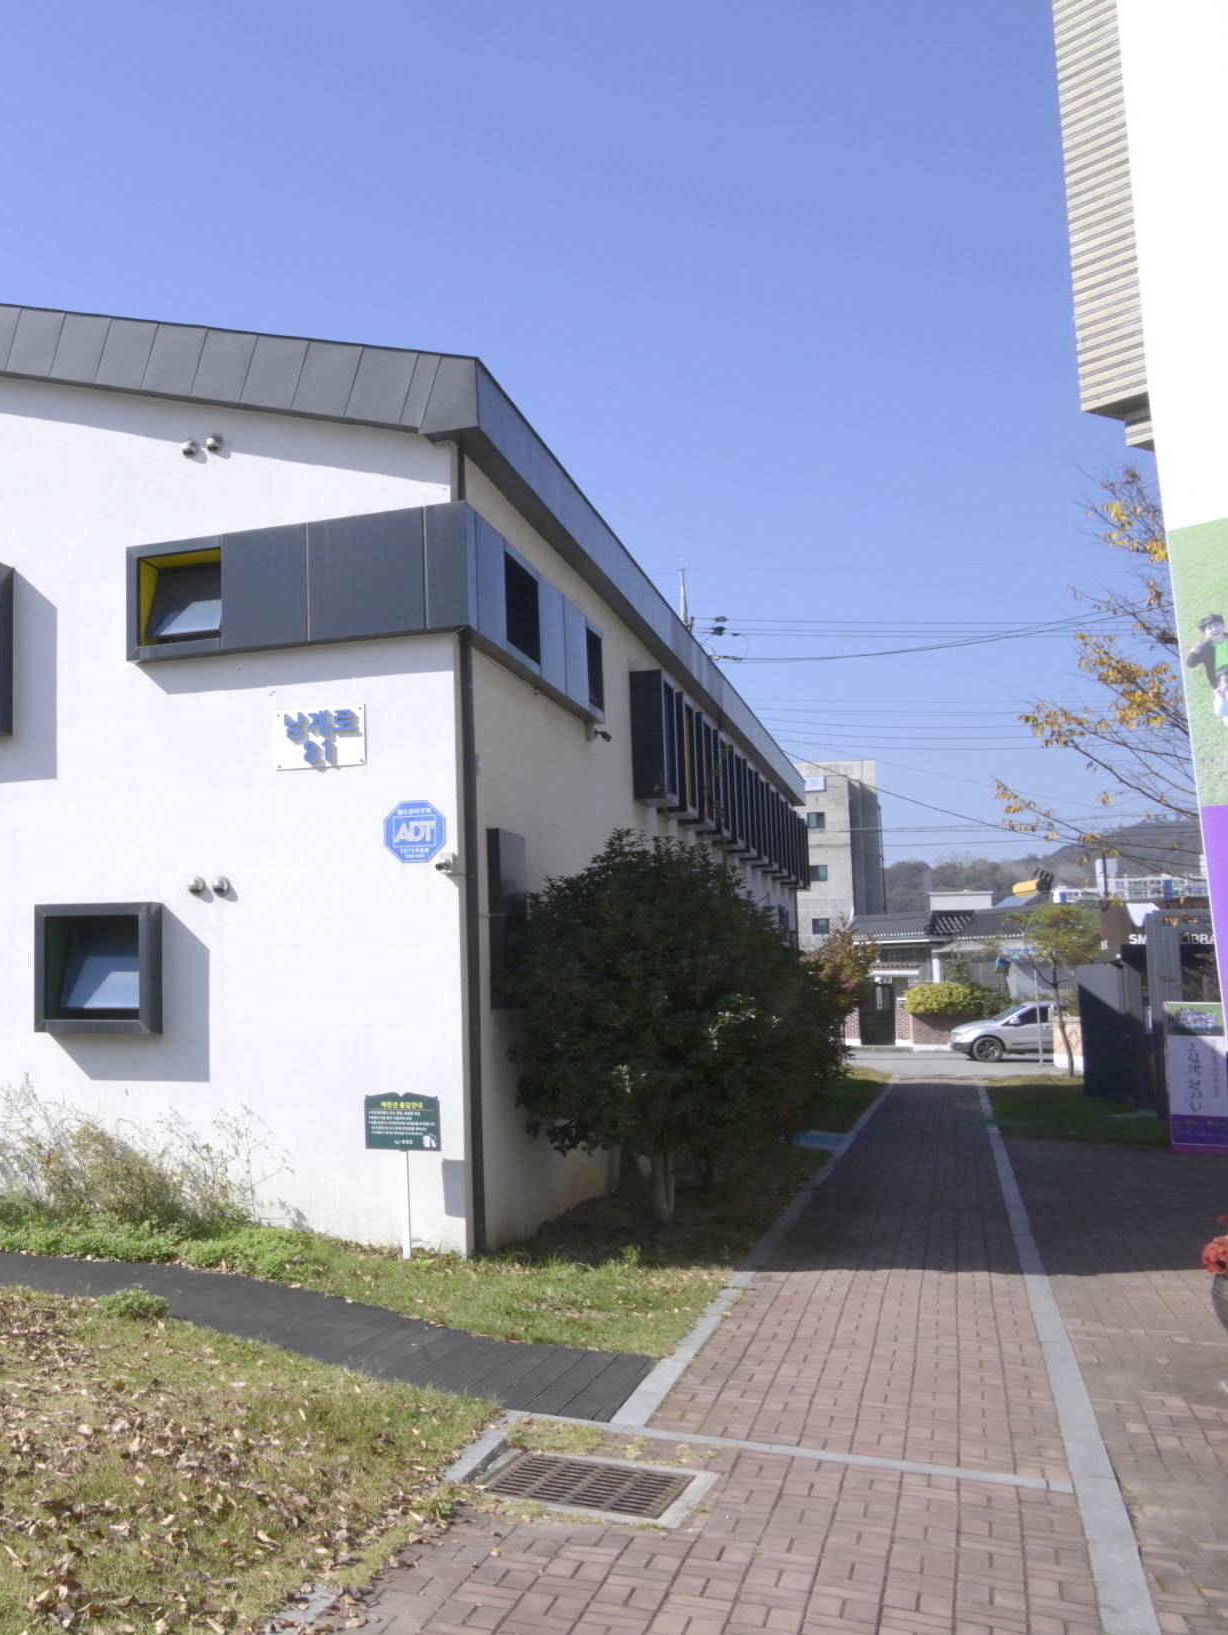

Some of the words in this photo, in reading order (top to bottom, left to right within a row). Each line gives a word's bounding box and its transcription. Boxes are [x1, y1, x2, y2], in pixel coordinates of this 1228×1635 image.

[284, 709, 355, 739] 남계로
[303, 739, 330, 763] 81
[394, 821, 435, 842] ADT
